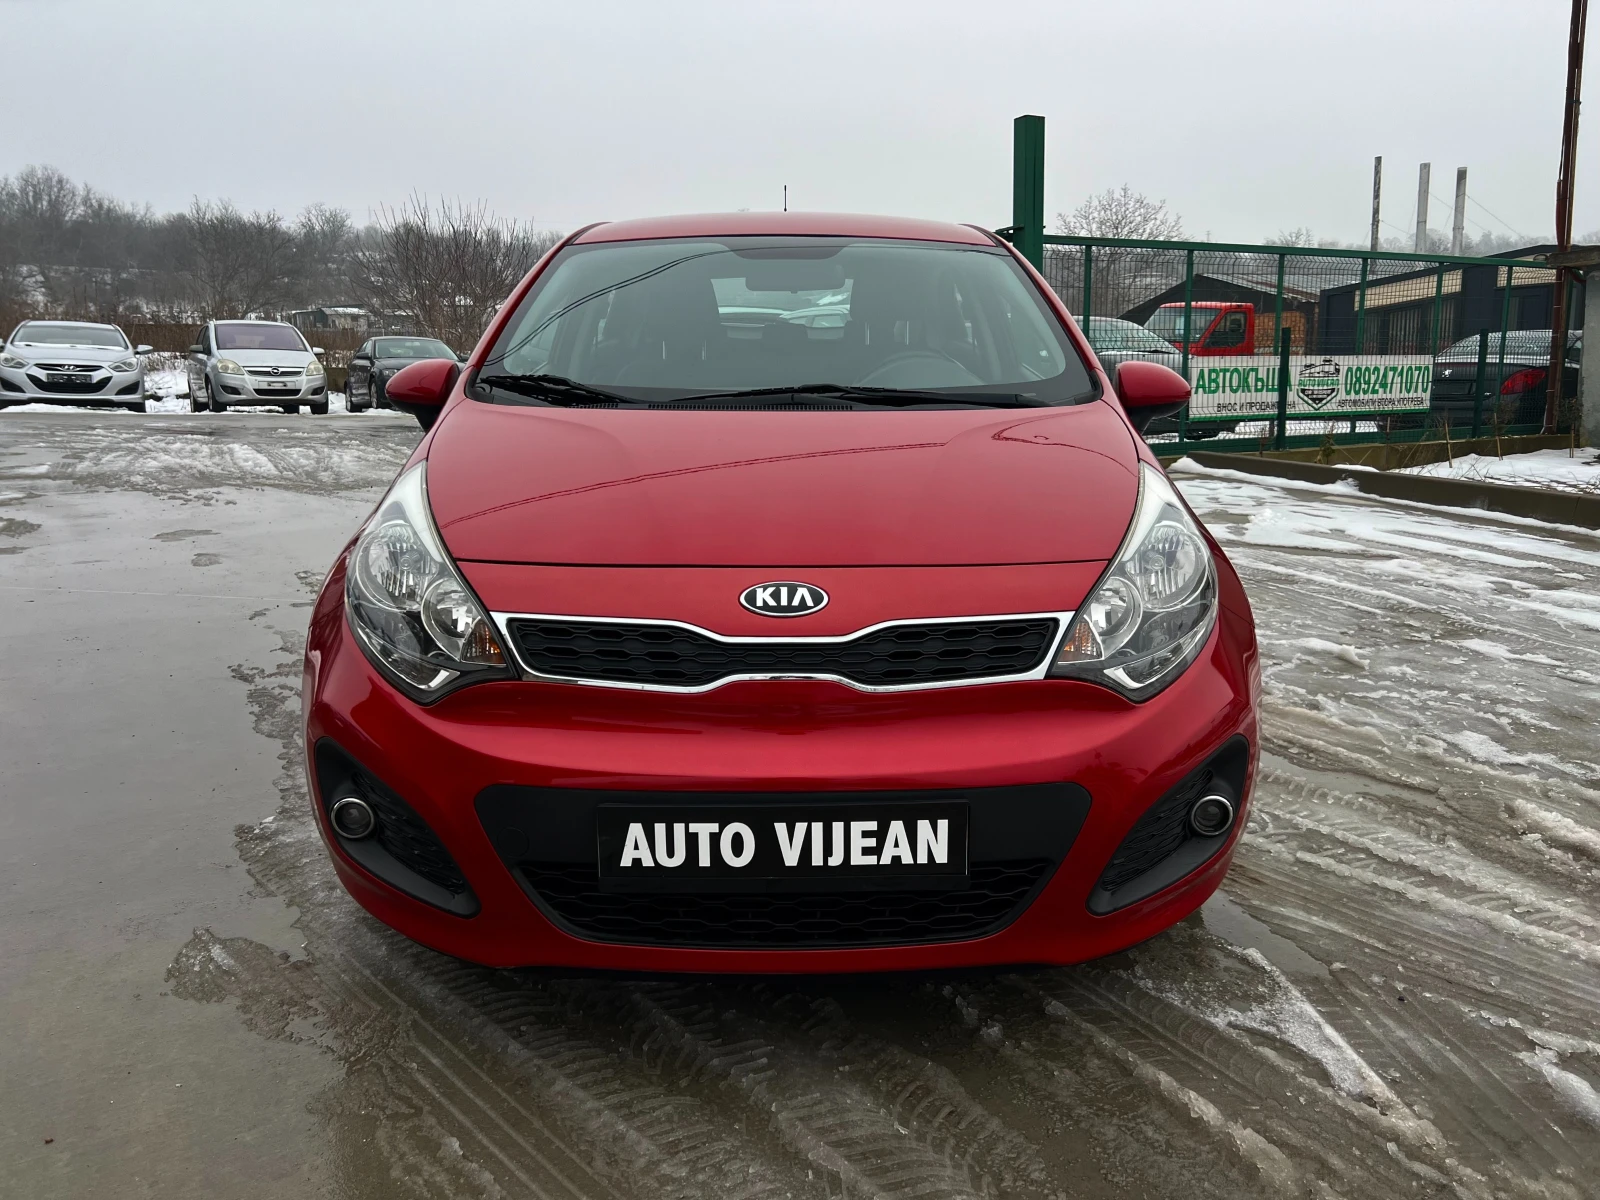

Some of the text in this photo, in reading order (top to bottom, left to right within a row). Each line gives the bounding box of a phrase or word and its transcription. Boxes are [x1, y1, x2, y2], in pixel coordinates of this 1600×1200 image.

[1345, 366, 1430, 395] 0892471070
[1217, 402, 1238, 412] ВНОС
[1246, 401, 1278, 411] ПРОДАЖ
[755, 586, 814, 606] KIA
[619, 819, 949, 868] AUTO VIJEAN
